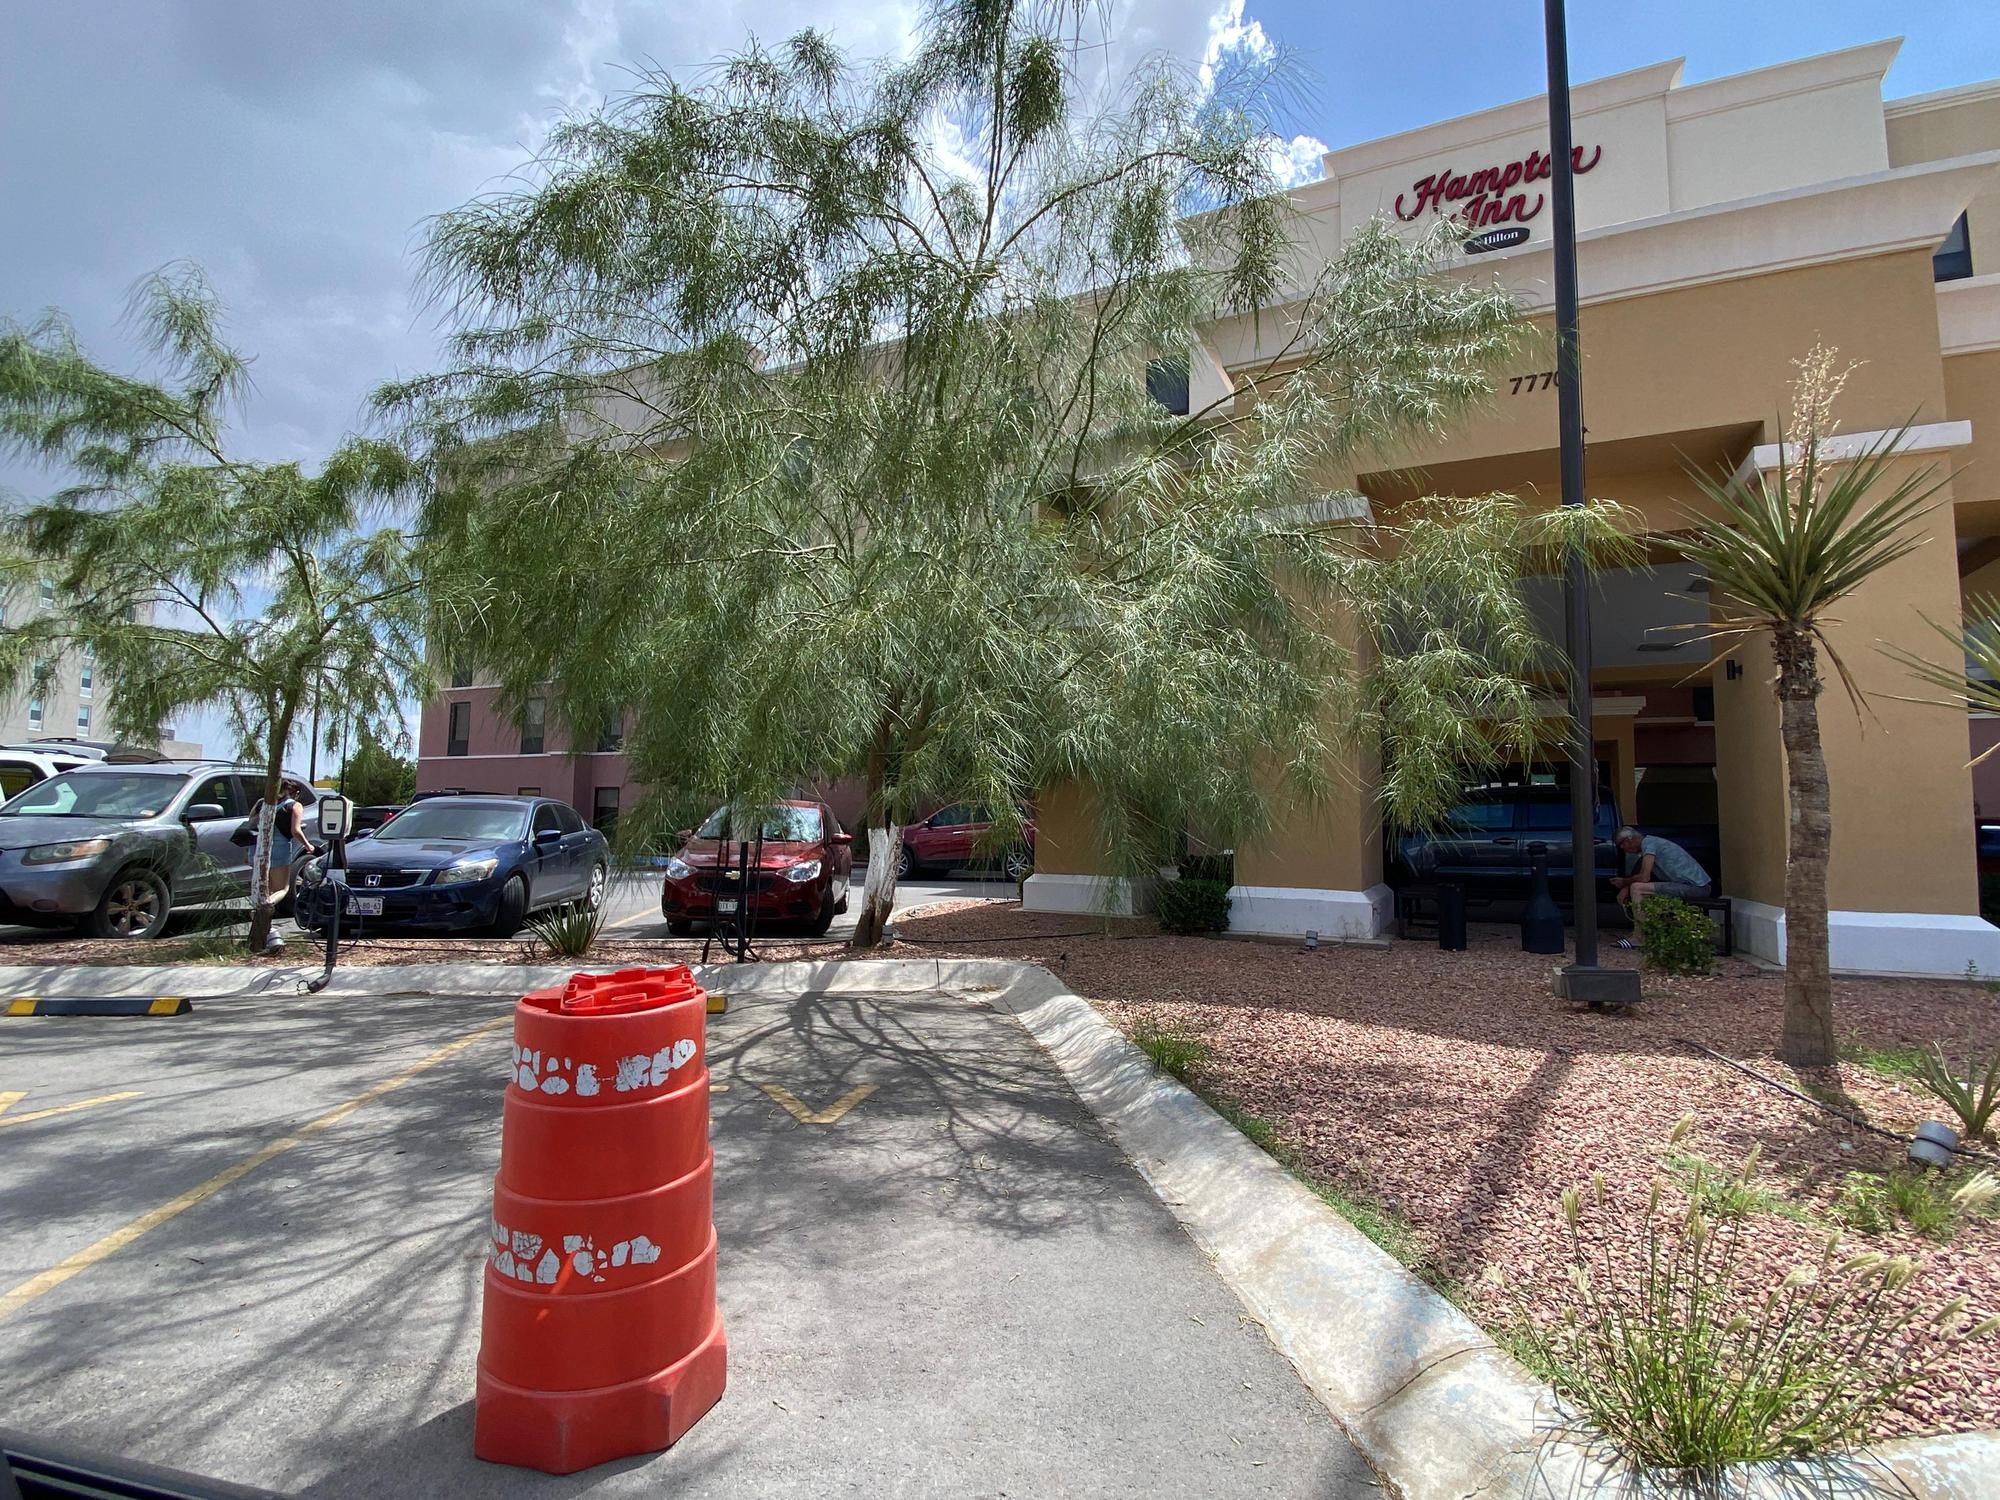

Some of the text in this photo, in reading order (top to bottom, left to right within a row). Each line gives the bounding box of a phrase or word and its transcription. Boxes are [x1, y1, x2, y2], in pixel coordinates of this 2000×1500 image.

[1395, 145, 1602, 222] Hampton
[1450, 193, 1544, 231] Inn
[1484, 231, 1519, 245] Hilton
